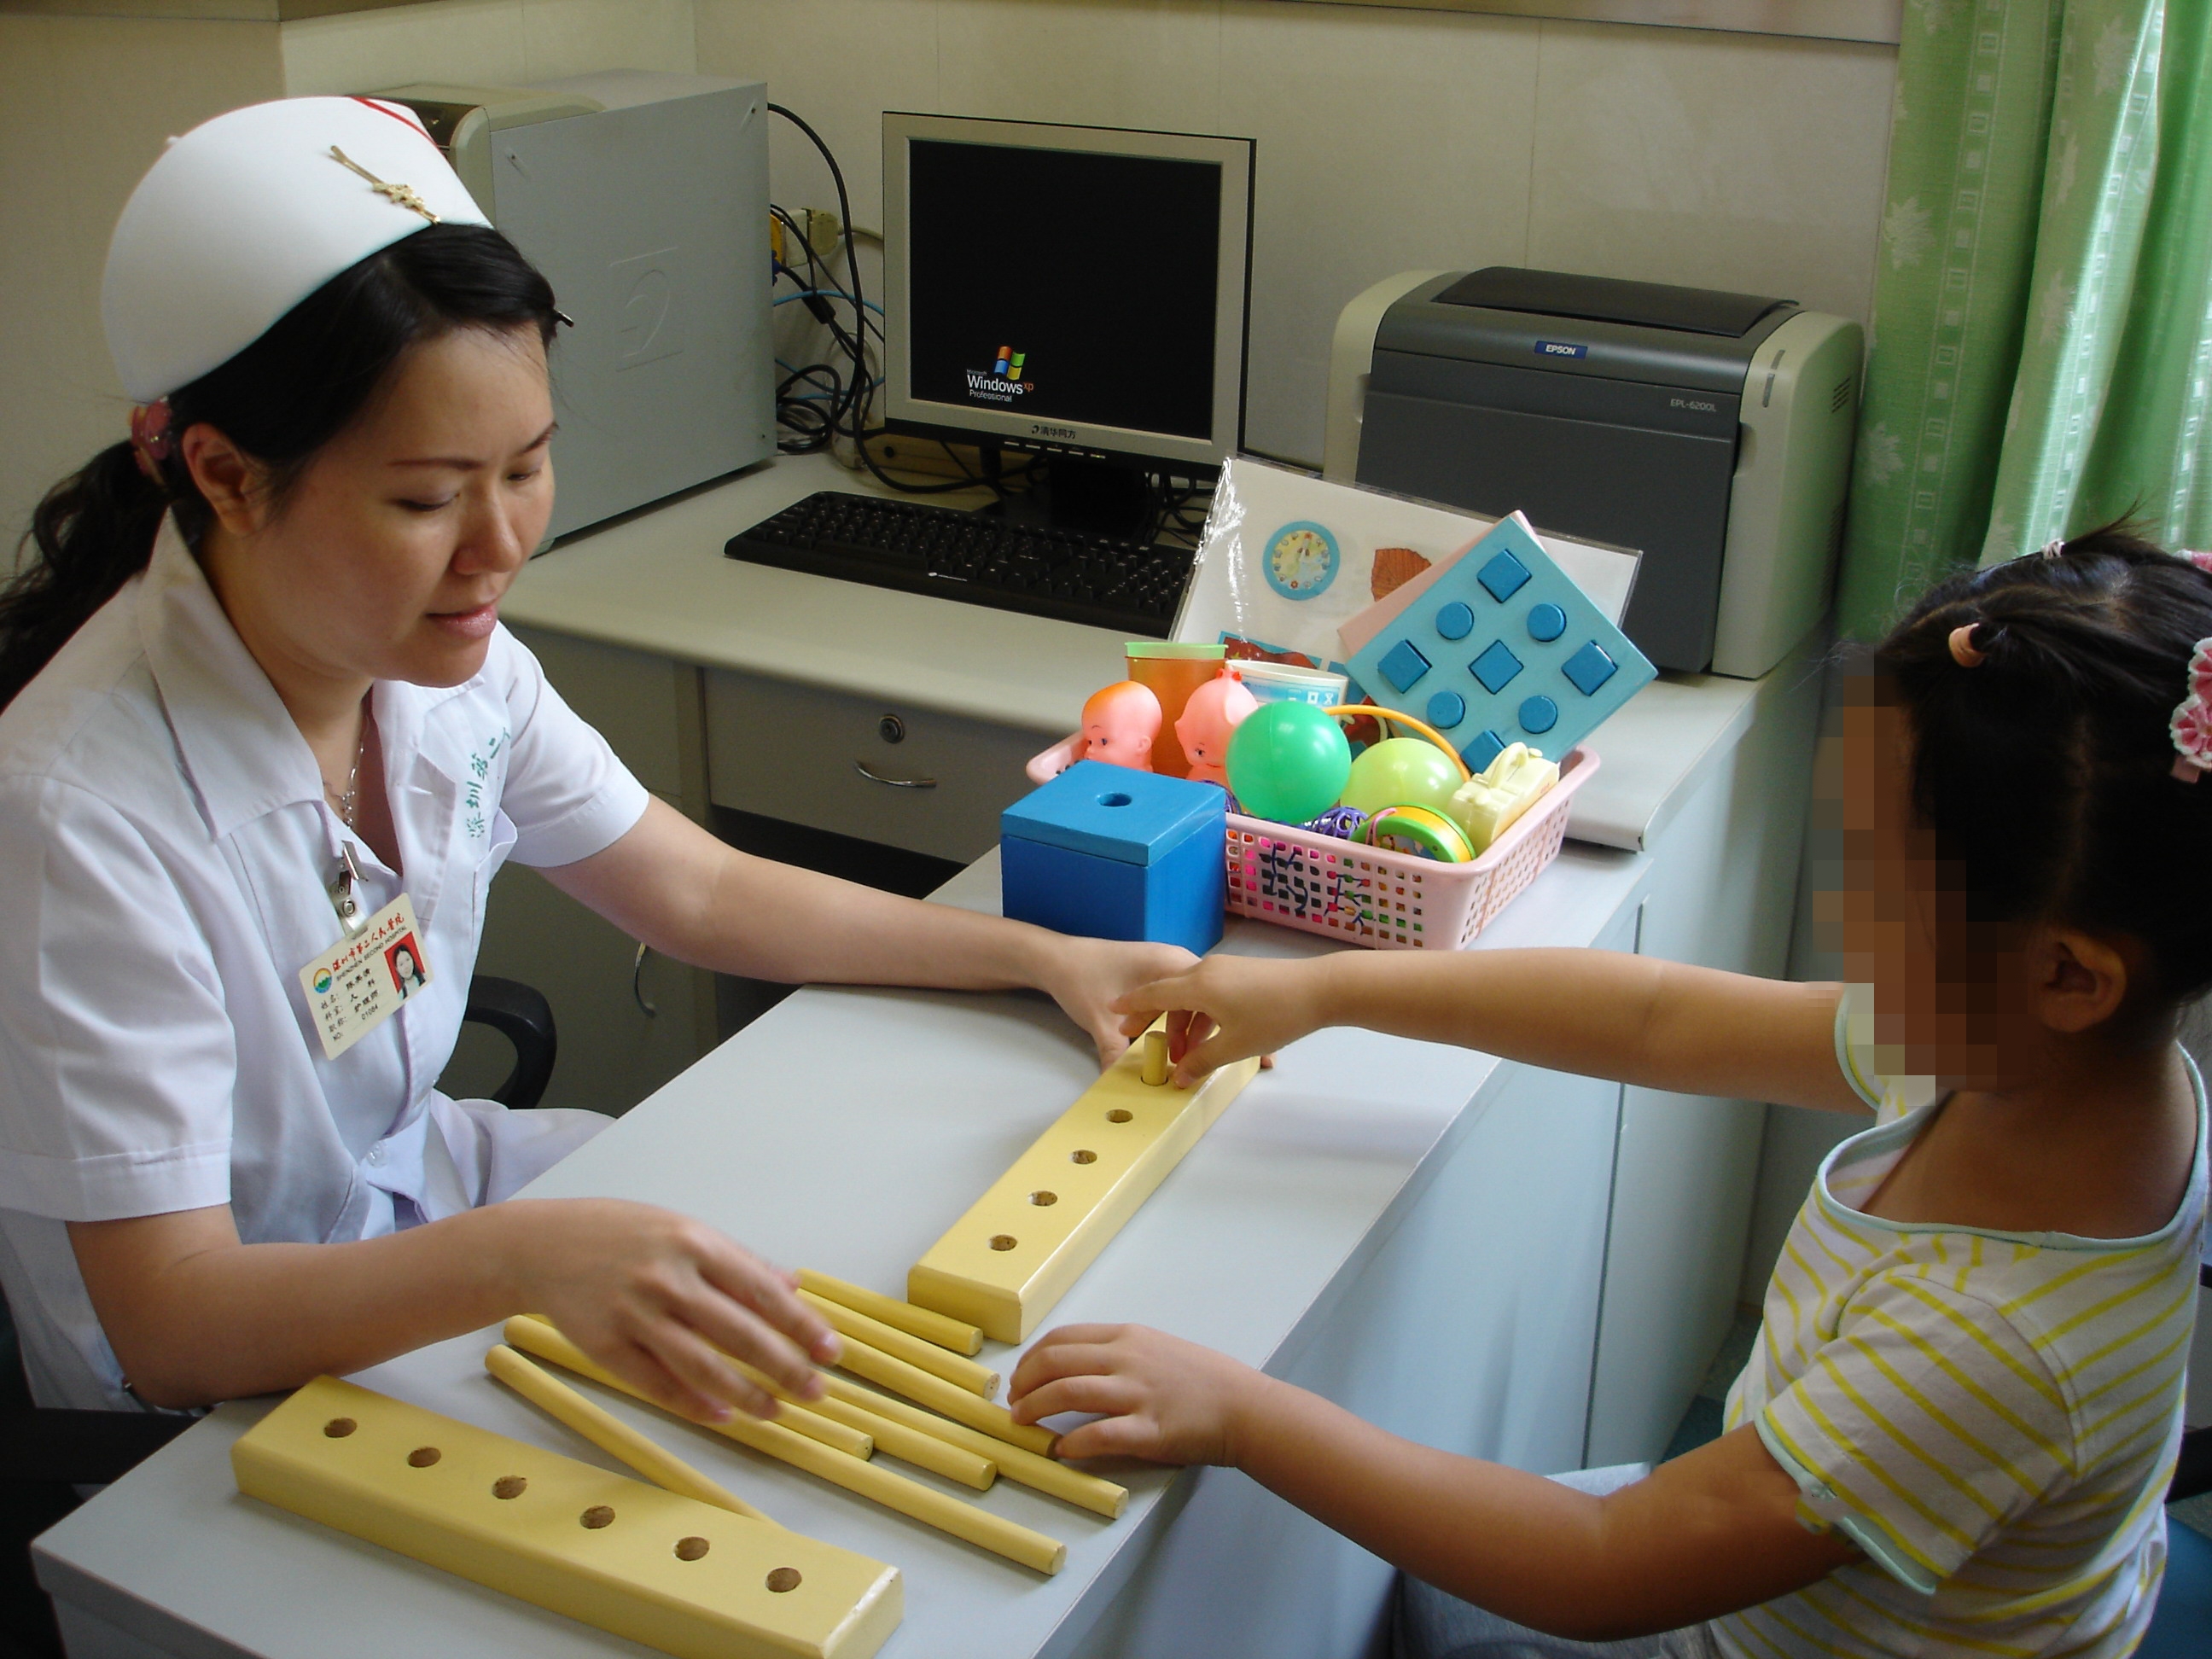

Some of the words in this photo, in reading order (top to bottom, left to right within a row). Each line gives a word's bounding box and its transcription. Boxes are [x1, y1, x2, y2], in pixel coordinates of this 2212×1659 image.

[1545, 344, 1577, 357] EPSON
[967, 374, 1024, 395] Windows
[969, 388, 1012, 403] Professional
[1669, 398, 1717, 412] EPL-6200L
[1040, 426, 1077, 439] 清华同方
[364, 942, 384, 961] SECOND
[384, 925, 407, 945] HOSPITAL
